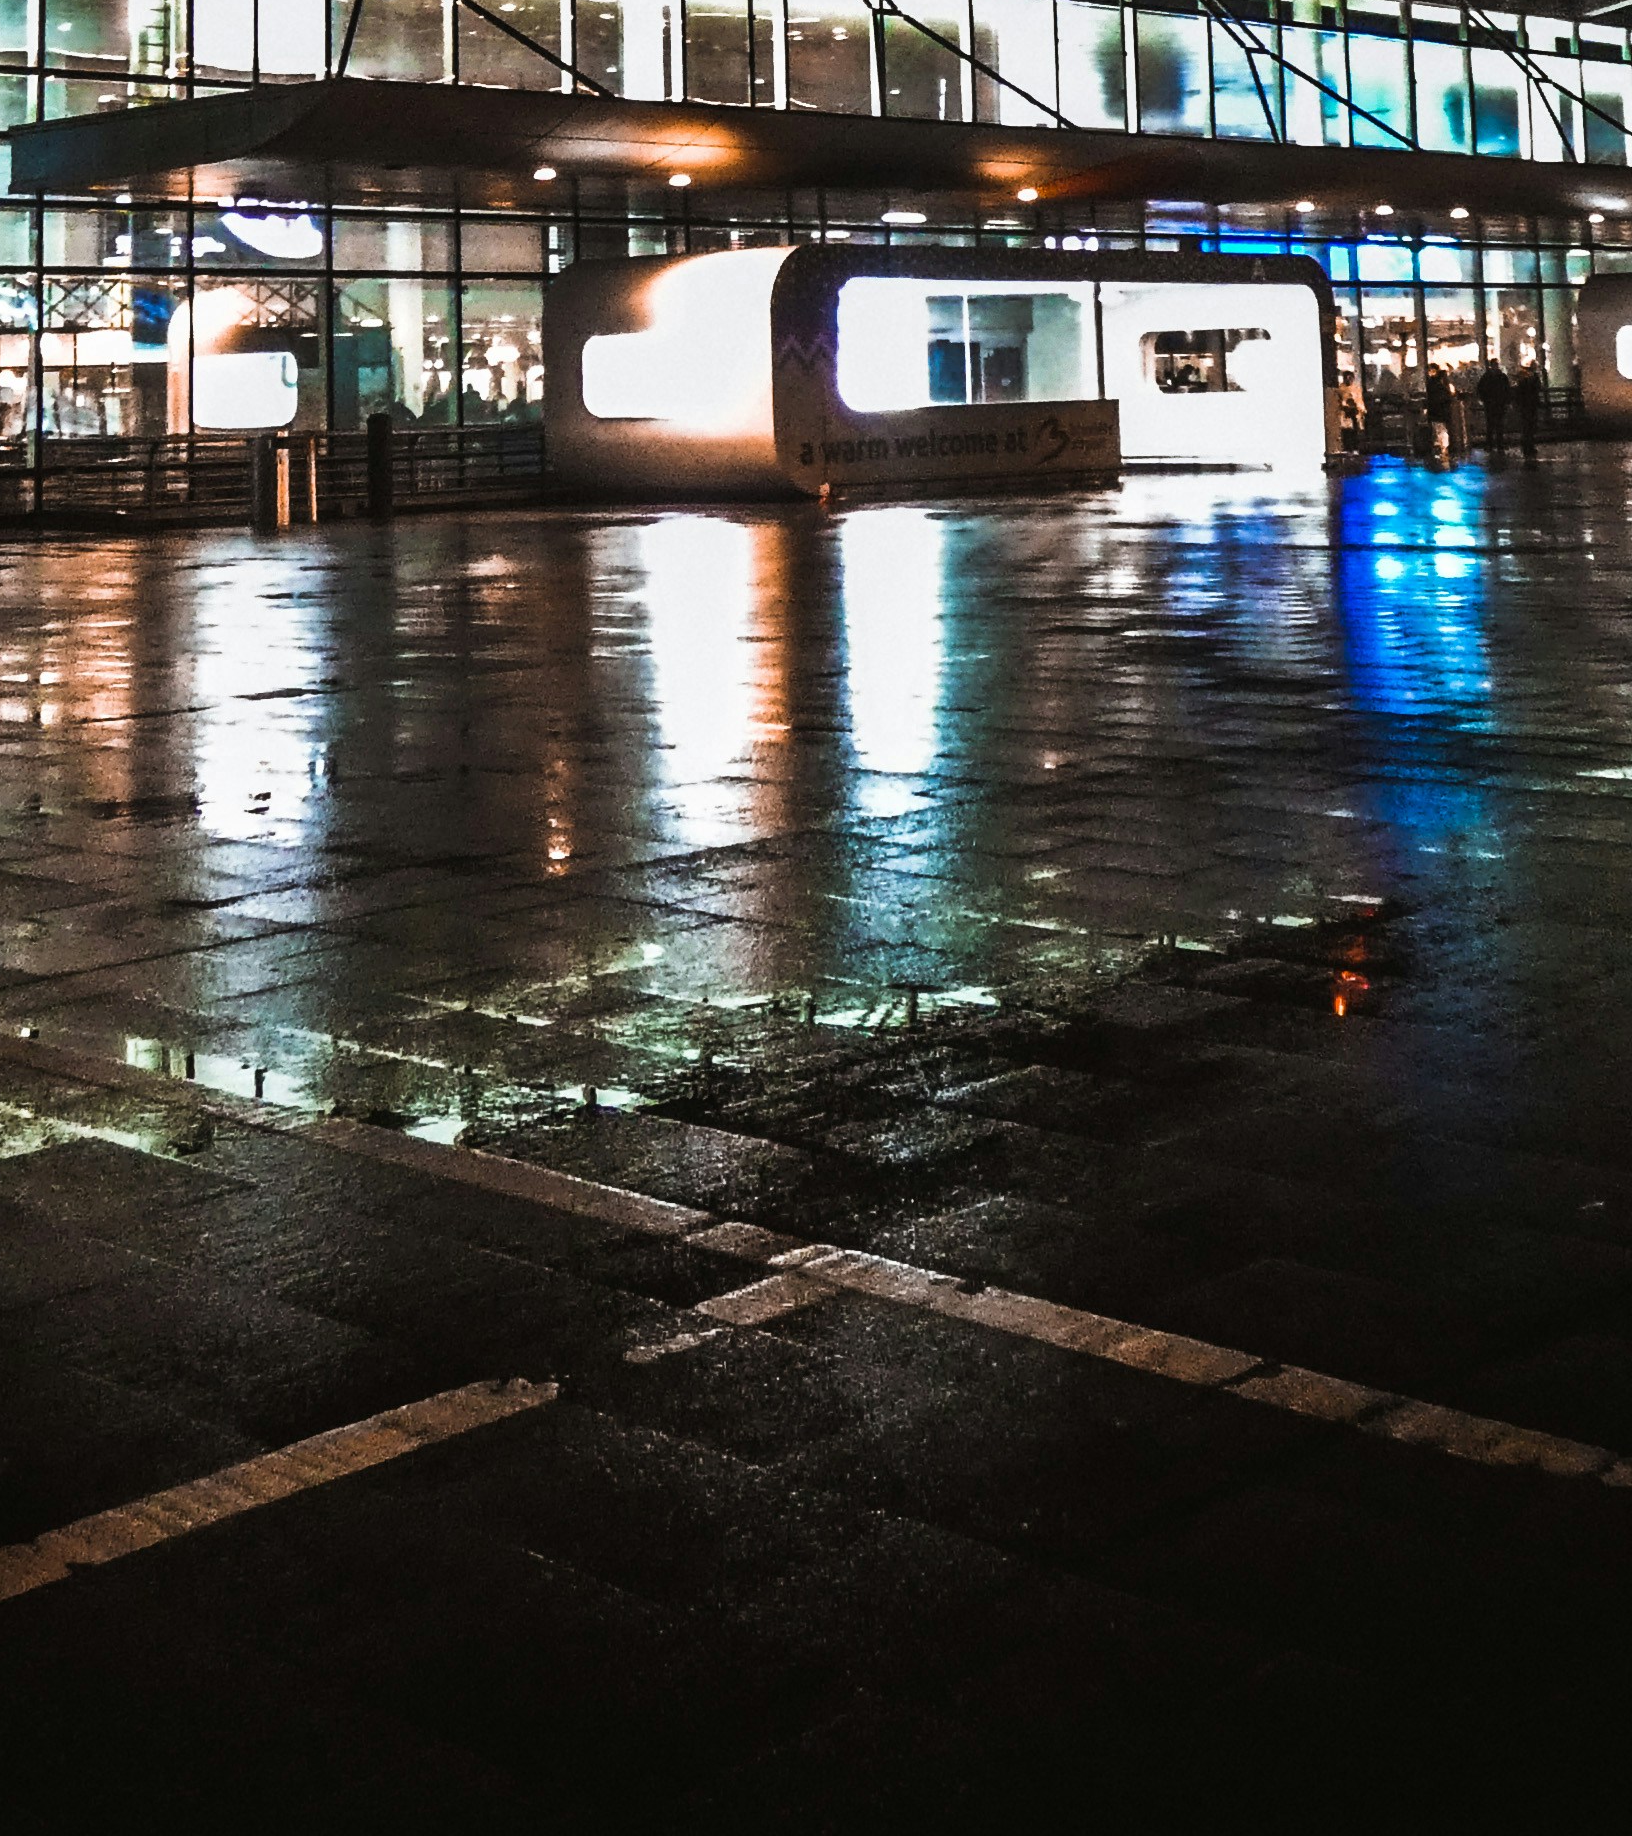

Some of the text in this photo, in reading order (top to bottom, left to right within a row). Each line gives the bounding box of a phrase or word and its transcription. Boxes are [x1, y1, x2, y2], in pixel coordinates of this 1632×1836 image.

[801, 426, 1027, 464] a warm welcome at
